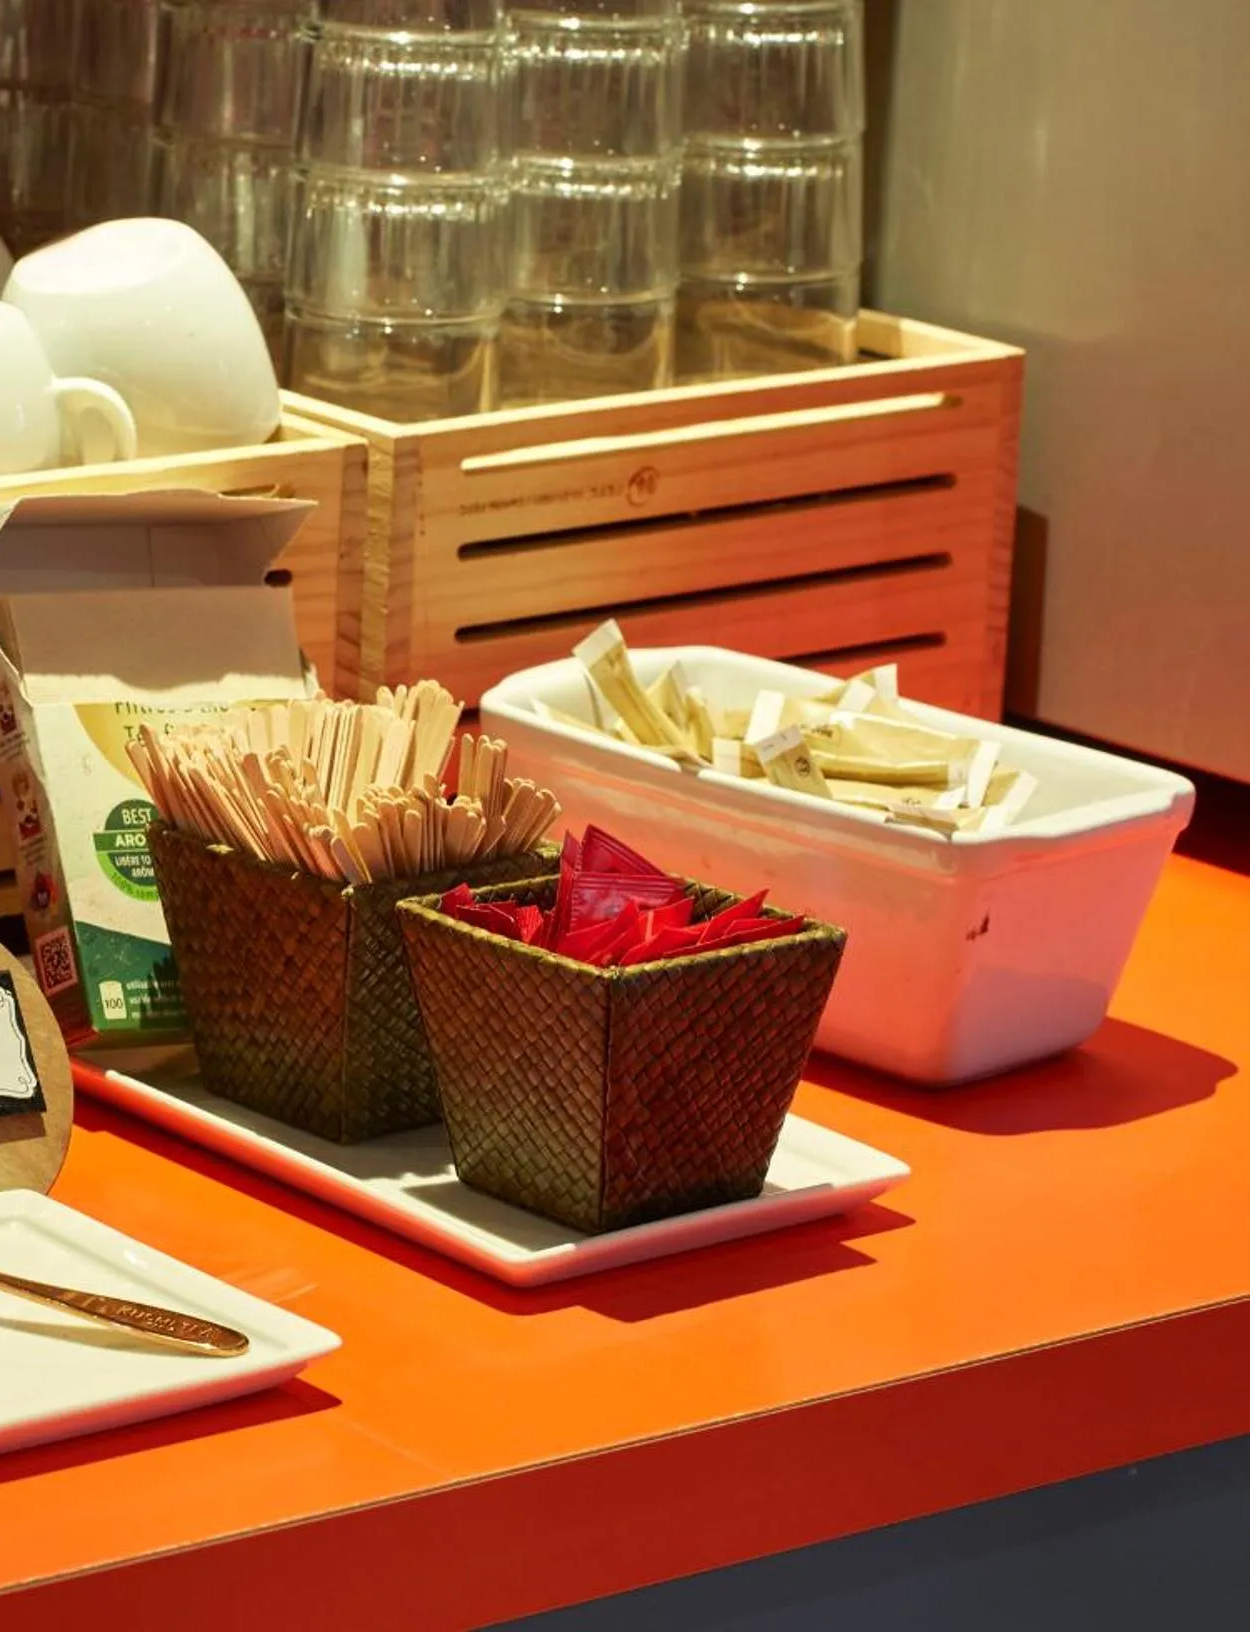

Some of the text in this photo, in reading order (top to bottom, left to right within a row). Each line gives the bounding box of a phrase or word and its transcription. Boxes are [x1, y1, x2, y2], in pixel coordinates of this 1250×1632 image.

[121, 808, 152, 825] BEST
[115, 833, 147, 848] ARO
[105, 998, 123, 1010] 100
